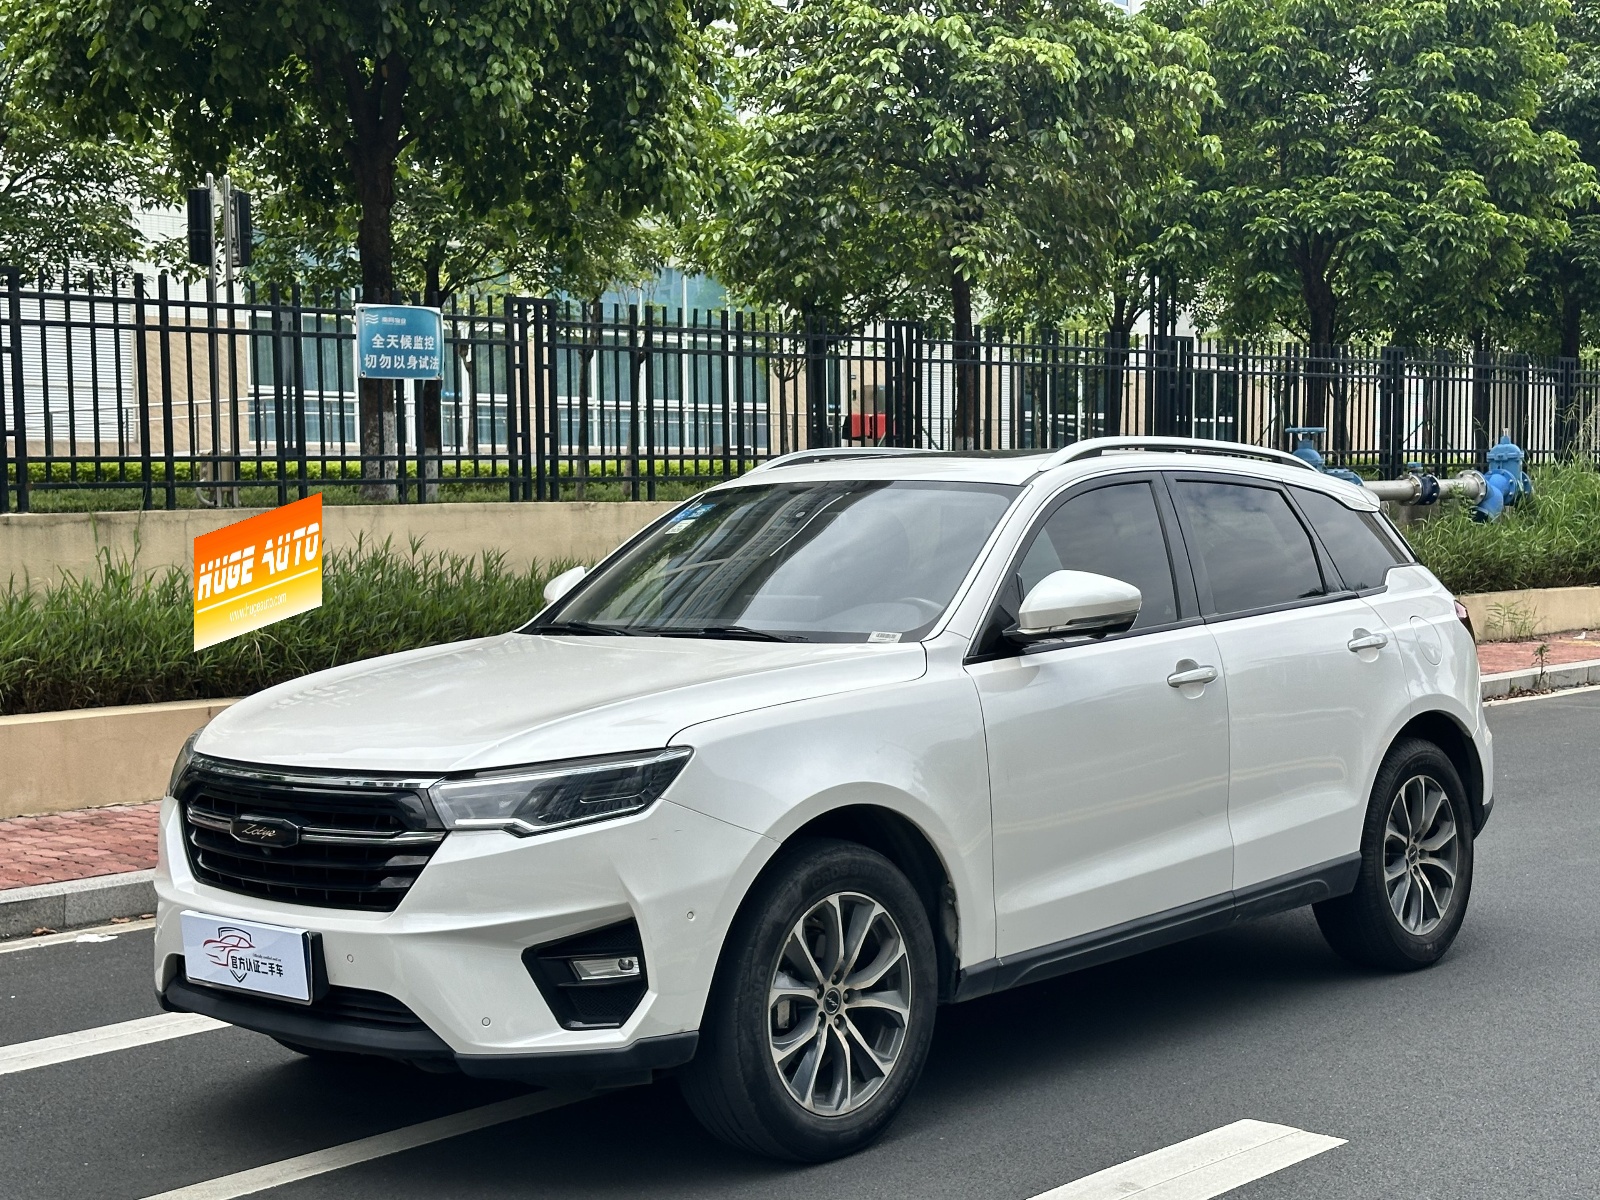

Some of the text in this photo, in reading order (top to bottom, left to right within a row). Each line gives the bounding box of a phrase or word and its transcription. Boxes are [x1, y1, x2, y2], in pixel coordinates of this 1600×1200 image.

[371, 333, 435, 351] 全天候监控
[364, 353, 440, 370] 切勿以身试法
[230, 956, 284, 977] 官方认证二手车
